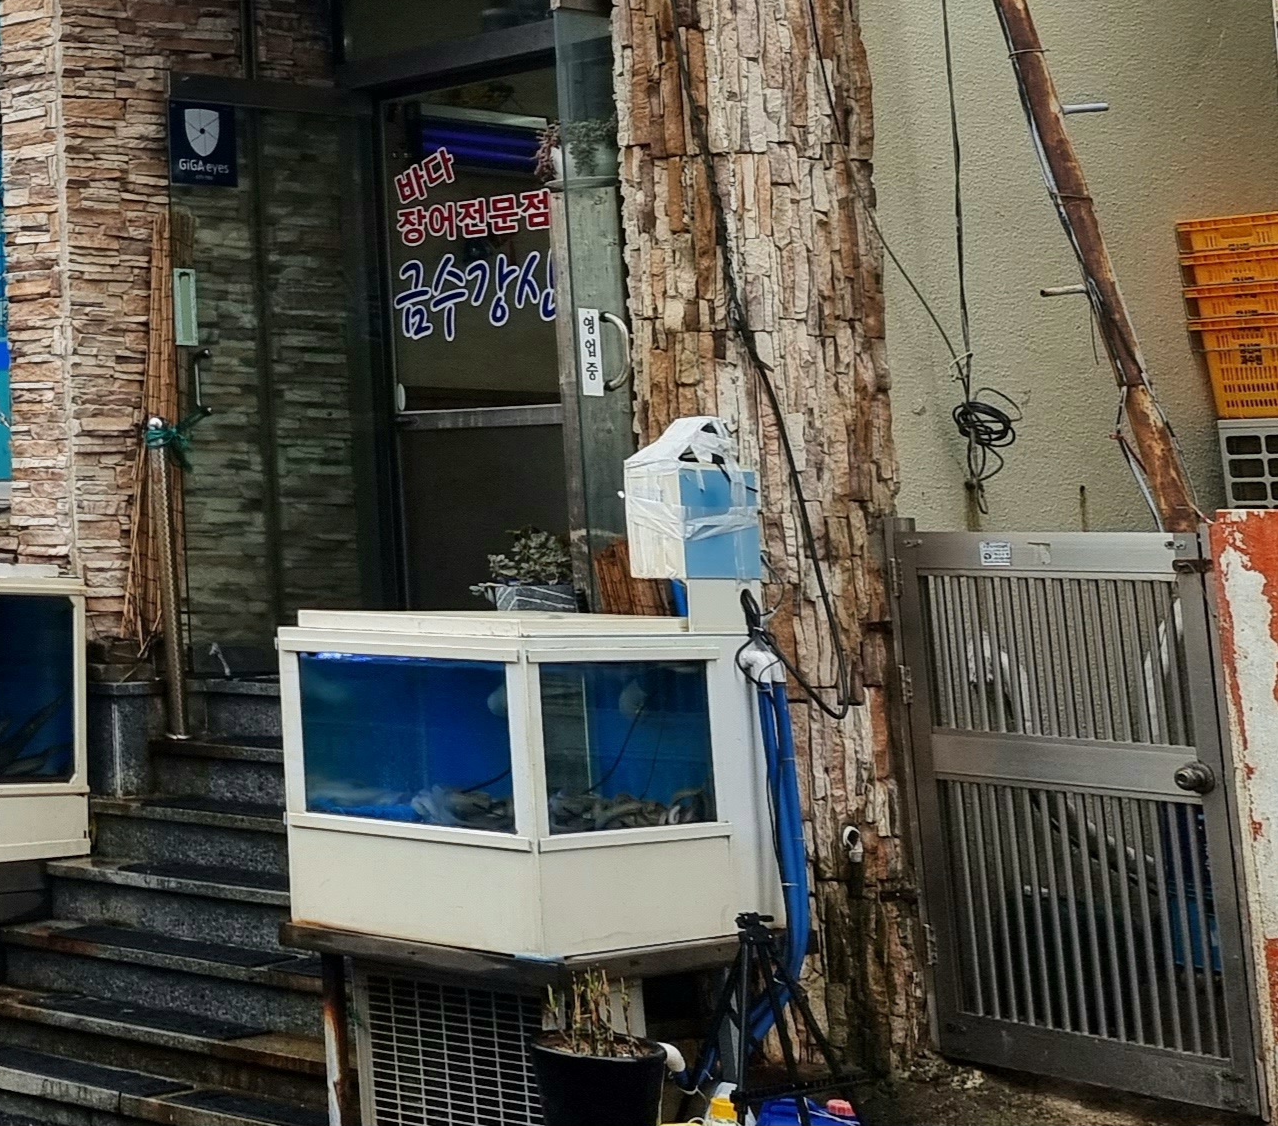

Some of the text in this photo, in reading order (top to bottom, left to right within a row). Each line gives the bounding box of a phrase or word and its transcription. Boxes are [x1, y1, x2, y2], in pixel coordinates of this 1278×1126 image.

[395, 147, 456, 204] 바다
[397, 189, 551, 246] 장어전문점
[583, 315, 599, 381] 영업중
